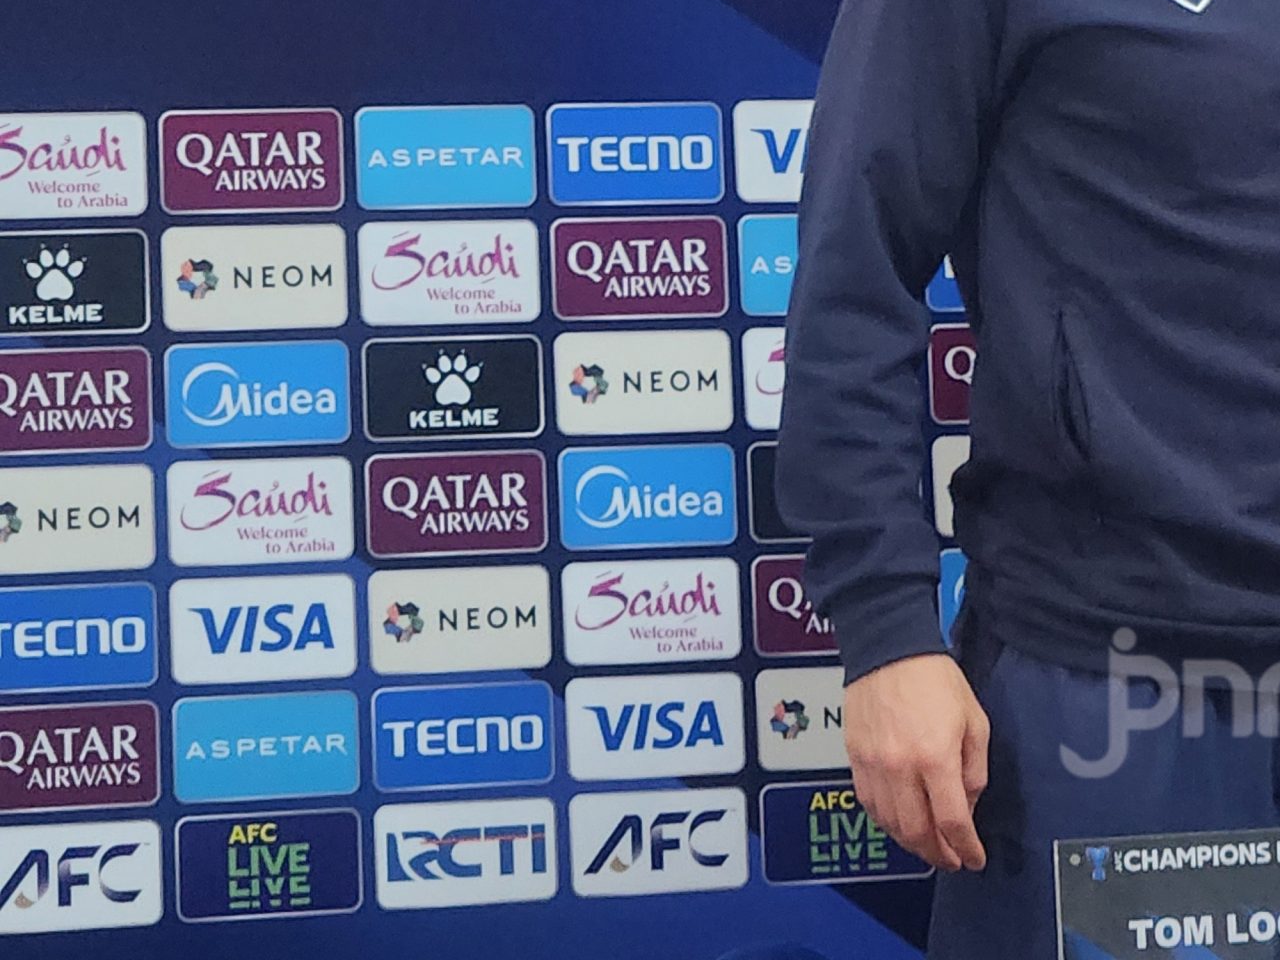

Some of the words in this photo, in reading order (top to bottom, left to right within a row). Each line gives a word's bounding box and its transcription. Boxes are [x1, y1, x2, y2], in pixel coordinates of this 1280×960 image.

[177, 131, 324, 171] QATAR
[368, 146, 524, 168] ASPETAR
[557, 135, 713, 171] TECNO
[28, 181, 101, 193] Welcome
[215, 169, 326, 191] AIRWAYS
[57, 197, 73, 208] to
[78, 193, 128, 208] Arabia
[372, 234, 520, 290] Saudi
[567, 239, 709, 281] QATAR
[233, 265, 332, 288] NEOM
[604, 276, 711, 298] AIRWAYS
[426, 287, 495, 301] Welcome
[9, 304, 103, 324] KELME
[455, 302, 470, 315] to
[473, 300, 522, 314] Arabia
[624, 369, 718, 393] NEOM
[207, 382, 336, 417] Midea
[20, 407, 133, 431] AIRWAYS
[410, 408, 499, 429] KELME
[180, 471, 332, 531] Saudi
[383, 473, 527, 518] QATAR
[602, 485, 723, 520] Midea
[38, 505, 140, 531] NEOM
[421, 509, 529, 534] AIRWAYS
[237, 526, 308, 540] Welcome
[266, 541, 281, 554] to
[285, 539, 335, 553] Arabia
[575, 571, 721, 630] Saudi
[187, 603, 335, 654] VISA
[440, 605, 536, 631] NEOM
[629, 626, 697, 640] Welcome
[657, 640, 671, 653] to
[675, 638, 723, 653] Arabia
[383, 715, 543, 757] TECNO
[582, 701, 723, 751] VISA
[186, 733, 347, 759] ASPETAR
[27, 762, 140, 790] AIRWAYS
[810, 791, 855, 811] AFC
[228, 823, 277, 845] AFC
[584, 809, 729, 875] AFC
[228, 843, 310, 877] LIVE
[387, 824, 546, 881] RCTI
[1123, 842, 1271, 872] CHAMPIONS
[0, 843, 141, 911] AFC
[1129, 915, 1213, 949] TOM
